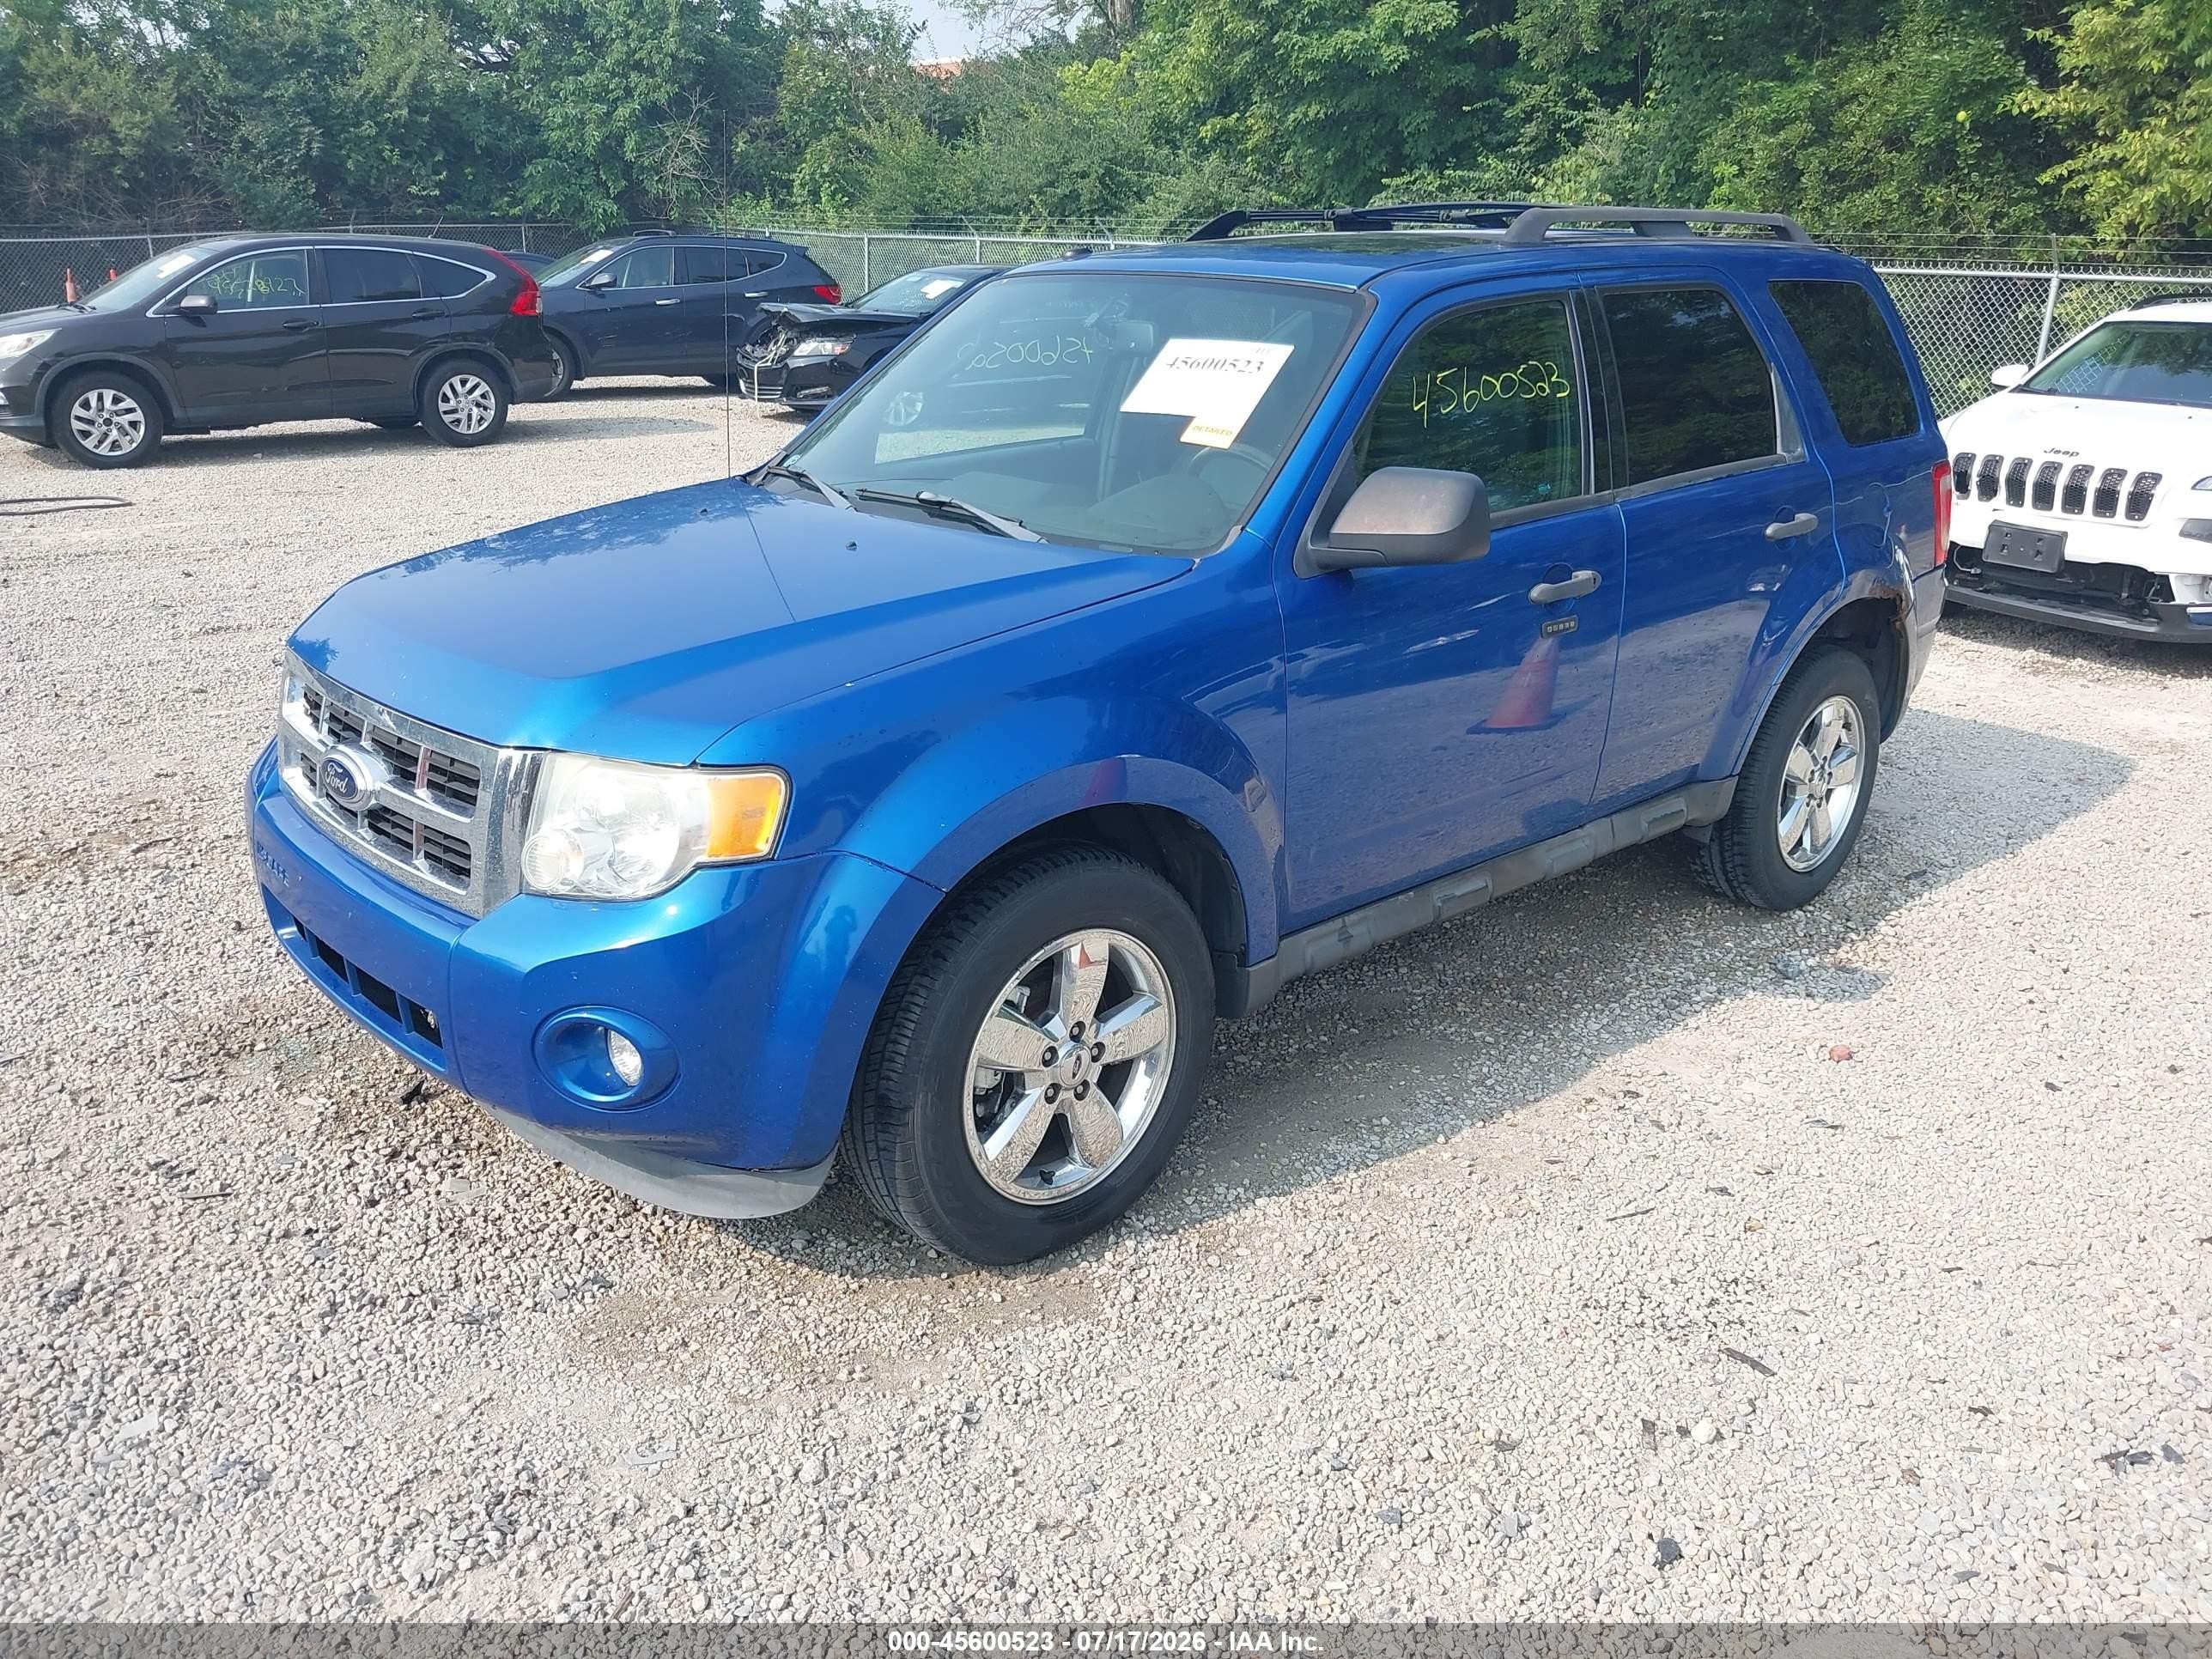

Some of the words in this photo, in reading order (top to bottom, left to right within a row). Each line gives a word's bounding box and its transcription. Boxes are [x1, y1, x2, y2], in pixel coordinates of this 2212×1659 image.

[1166, 356, 1265, 374] 45600523
[1413, 361, 1571, 428] 45600523
[1192, 425, 1233, 436] DETAILED
[2043, 447, 2080, 459] Jeep
[325, 762, 349, 793] Ford
